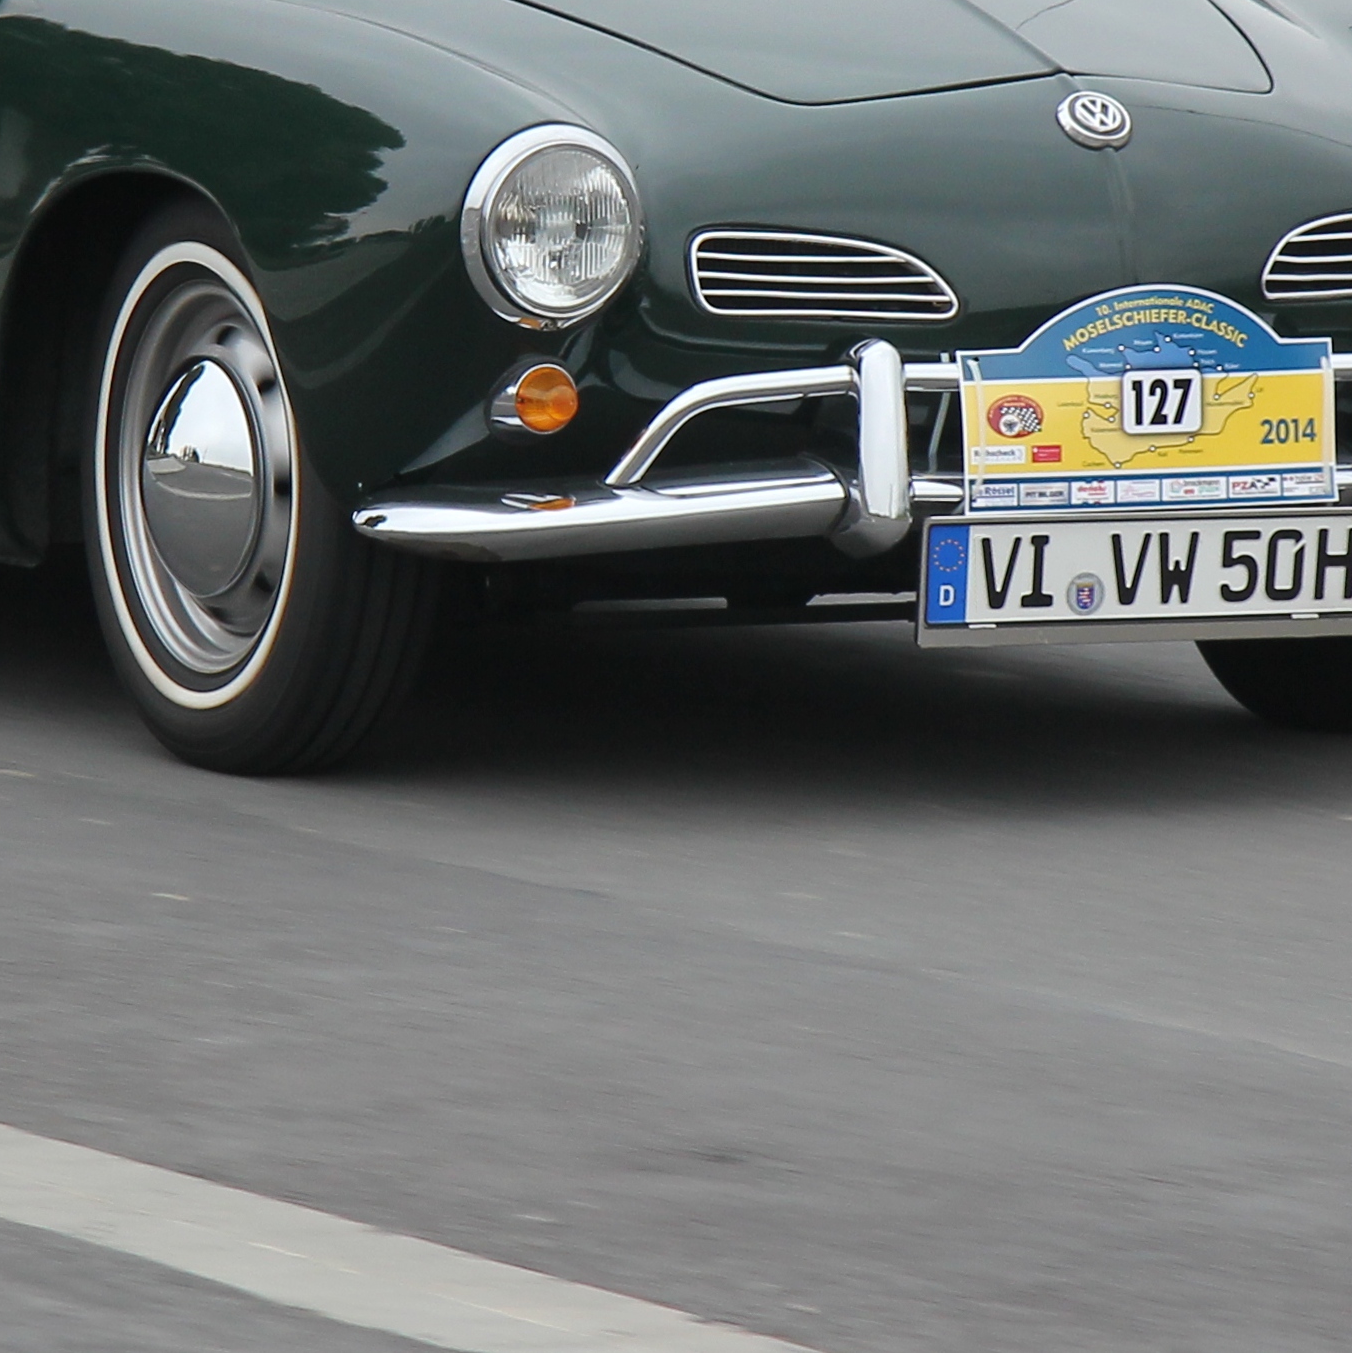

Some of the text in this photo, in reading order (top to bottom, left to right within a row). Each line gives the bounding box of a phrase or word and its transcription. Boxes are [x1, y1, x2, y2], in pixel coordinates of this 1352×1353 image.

[1114, 296, 1184, 311] Internationale
[1186, 298, 1215, 314] ADAC
[1062, 308, 1248, 351] MOSELSCHIEFER-CLASSIC
[1131, 378, 1193, 425] 127
[1259, 418, 1317, 446] 2014
[981, 535, 1054, 609] VI
[1112, 531, 1199, 606] VW
[939, 584, 956, 607] D
